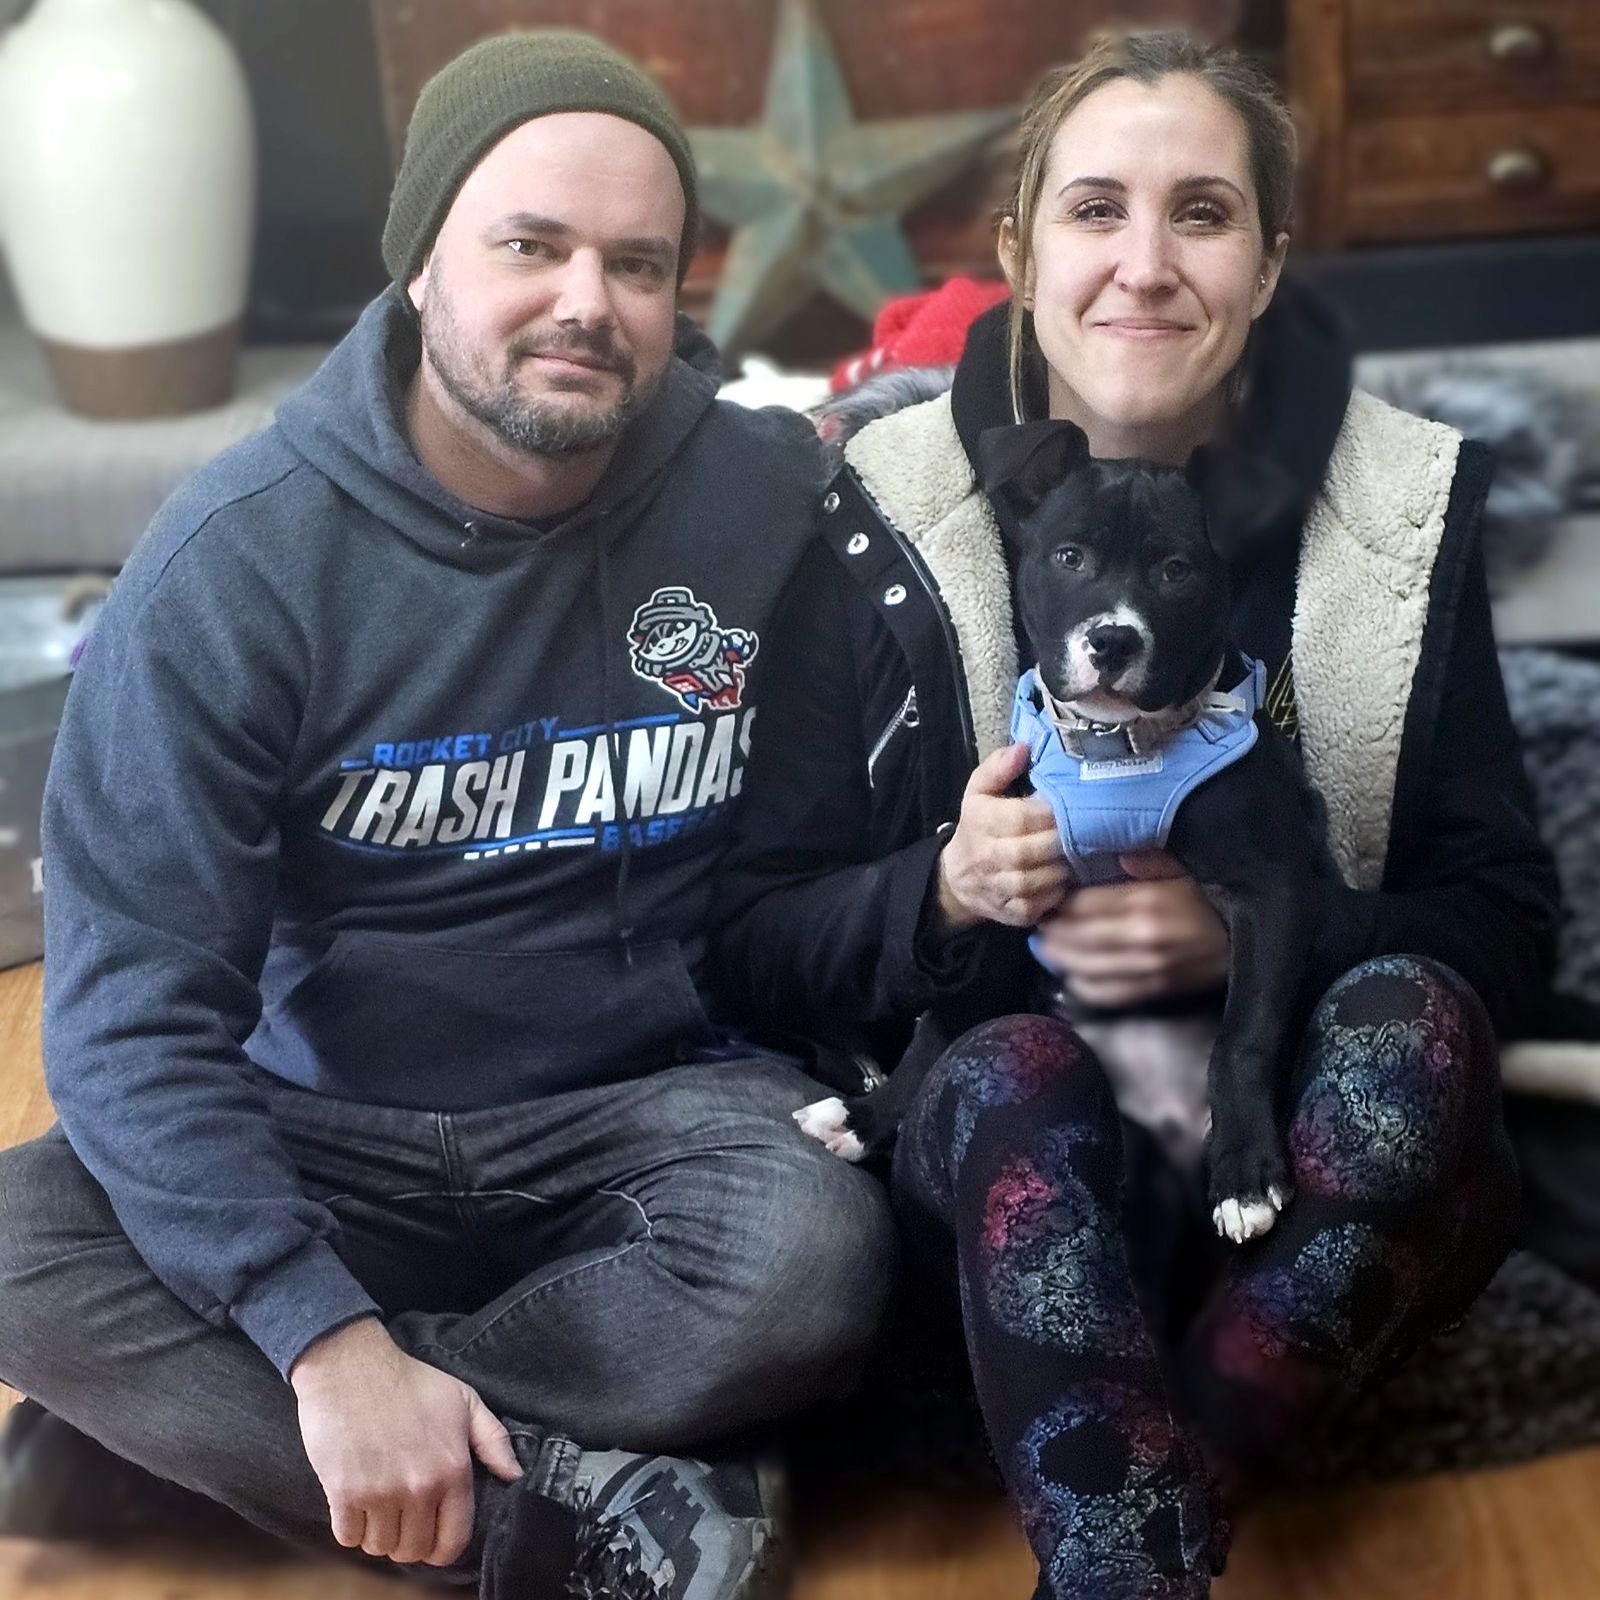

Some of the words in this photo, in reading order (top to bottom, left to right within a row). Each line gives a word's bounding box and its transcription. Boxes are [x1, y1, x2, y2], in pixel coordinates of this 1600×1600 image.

[372, 733, 492, 767] ROCKET
[501, 716, 560, 750] CITY
[320, 750, 526, 847] TRASH
